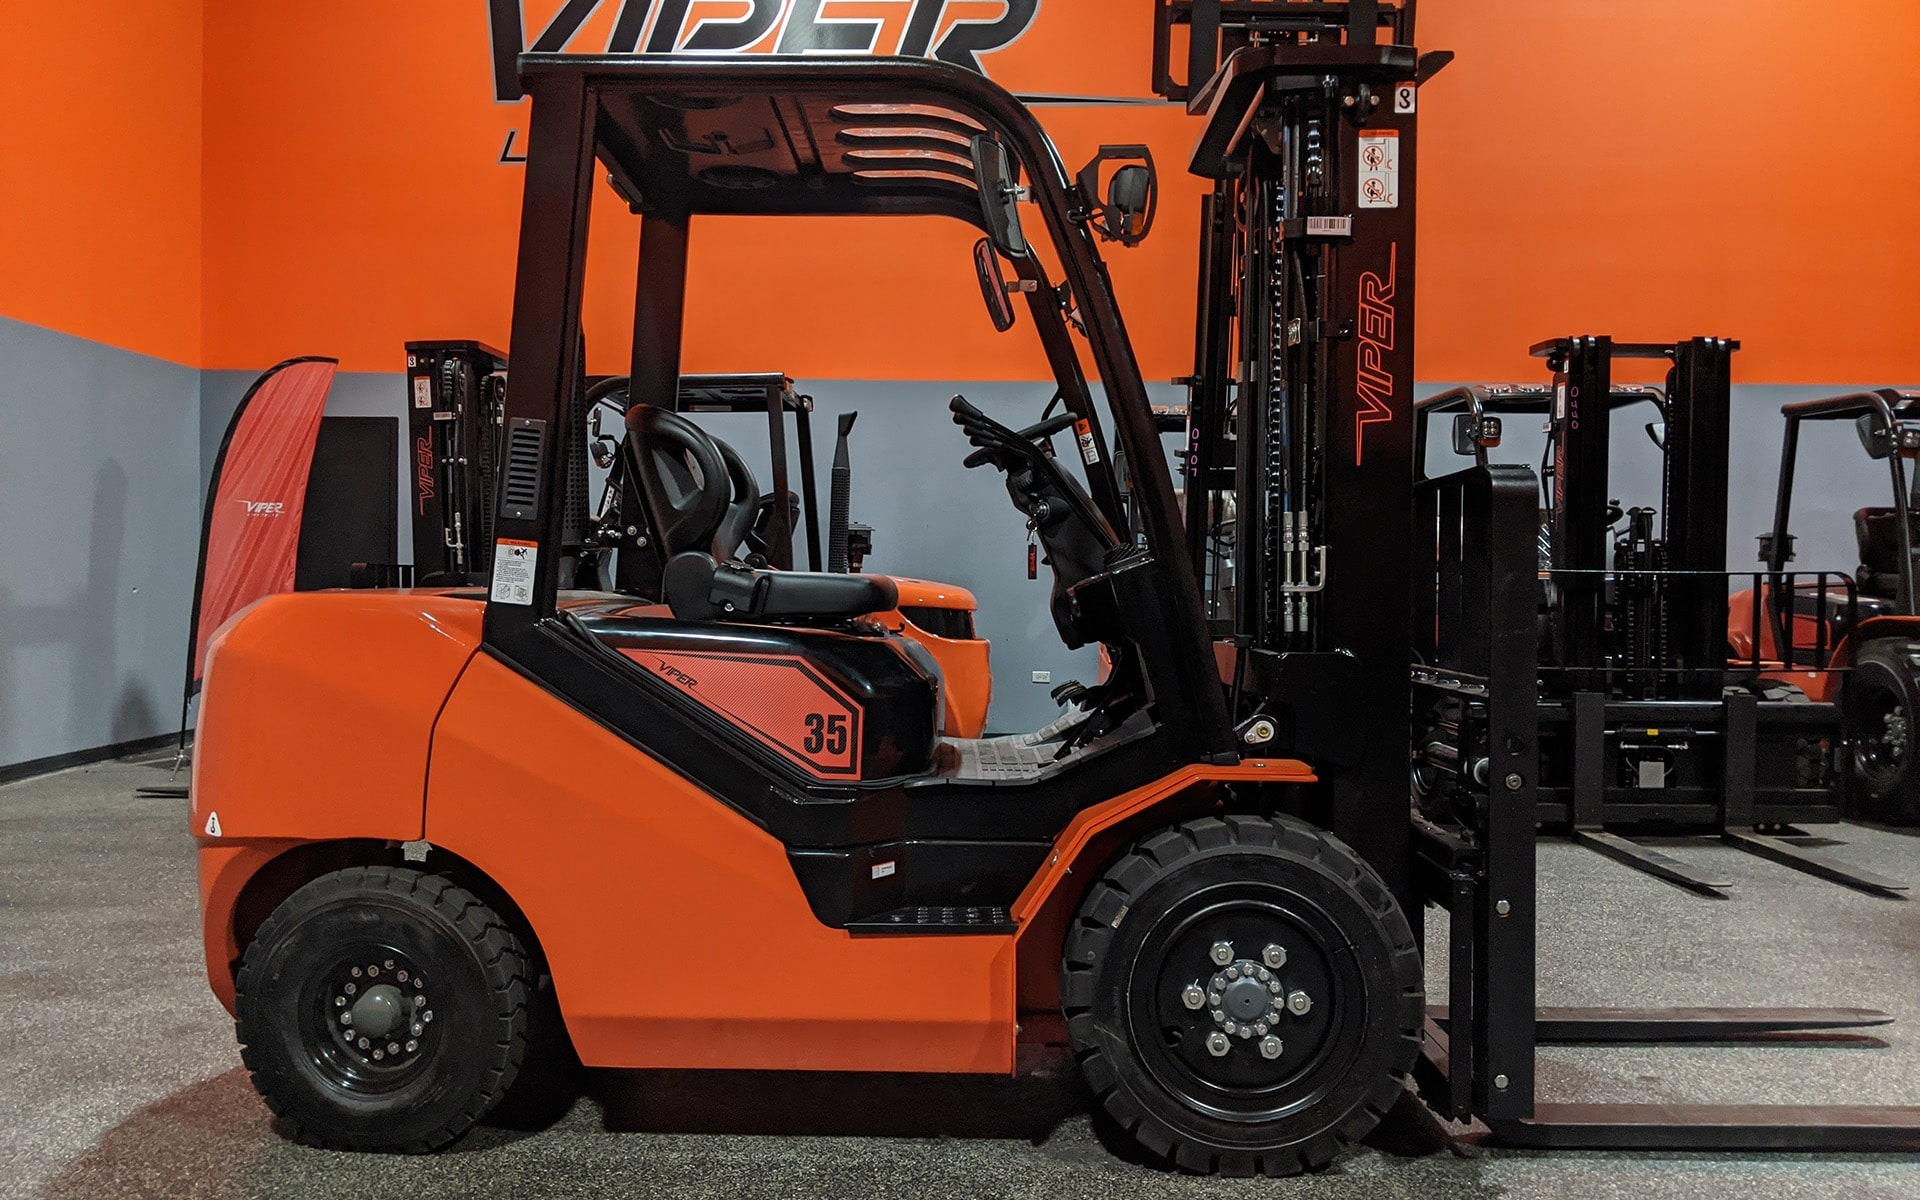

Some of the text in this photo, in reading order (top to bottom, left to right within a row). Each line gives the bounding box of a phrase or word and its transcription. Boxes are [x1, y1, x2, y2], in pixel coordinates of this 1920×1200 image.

[1357, 242, 1396, 466] VIPER
[418, 425, 434, 516] VIPER
[234, 499, 285, 514] VIPER
[652, 655, 698, 689] VIPER
[803, 713, 847, 755] 35
